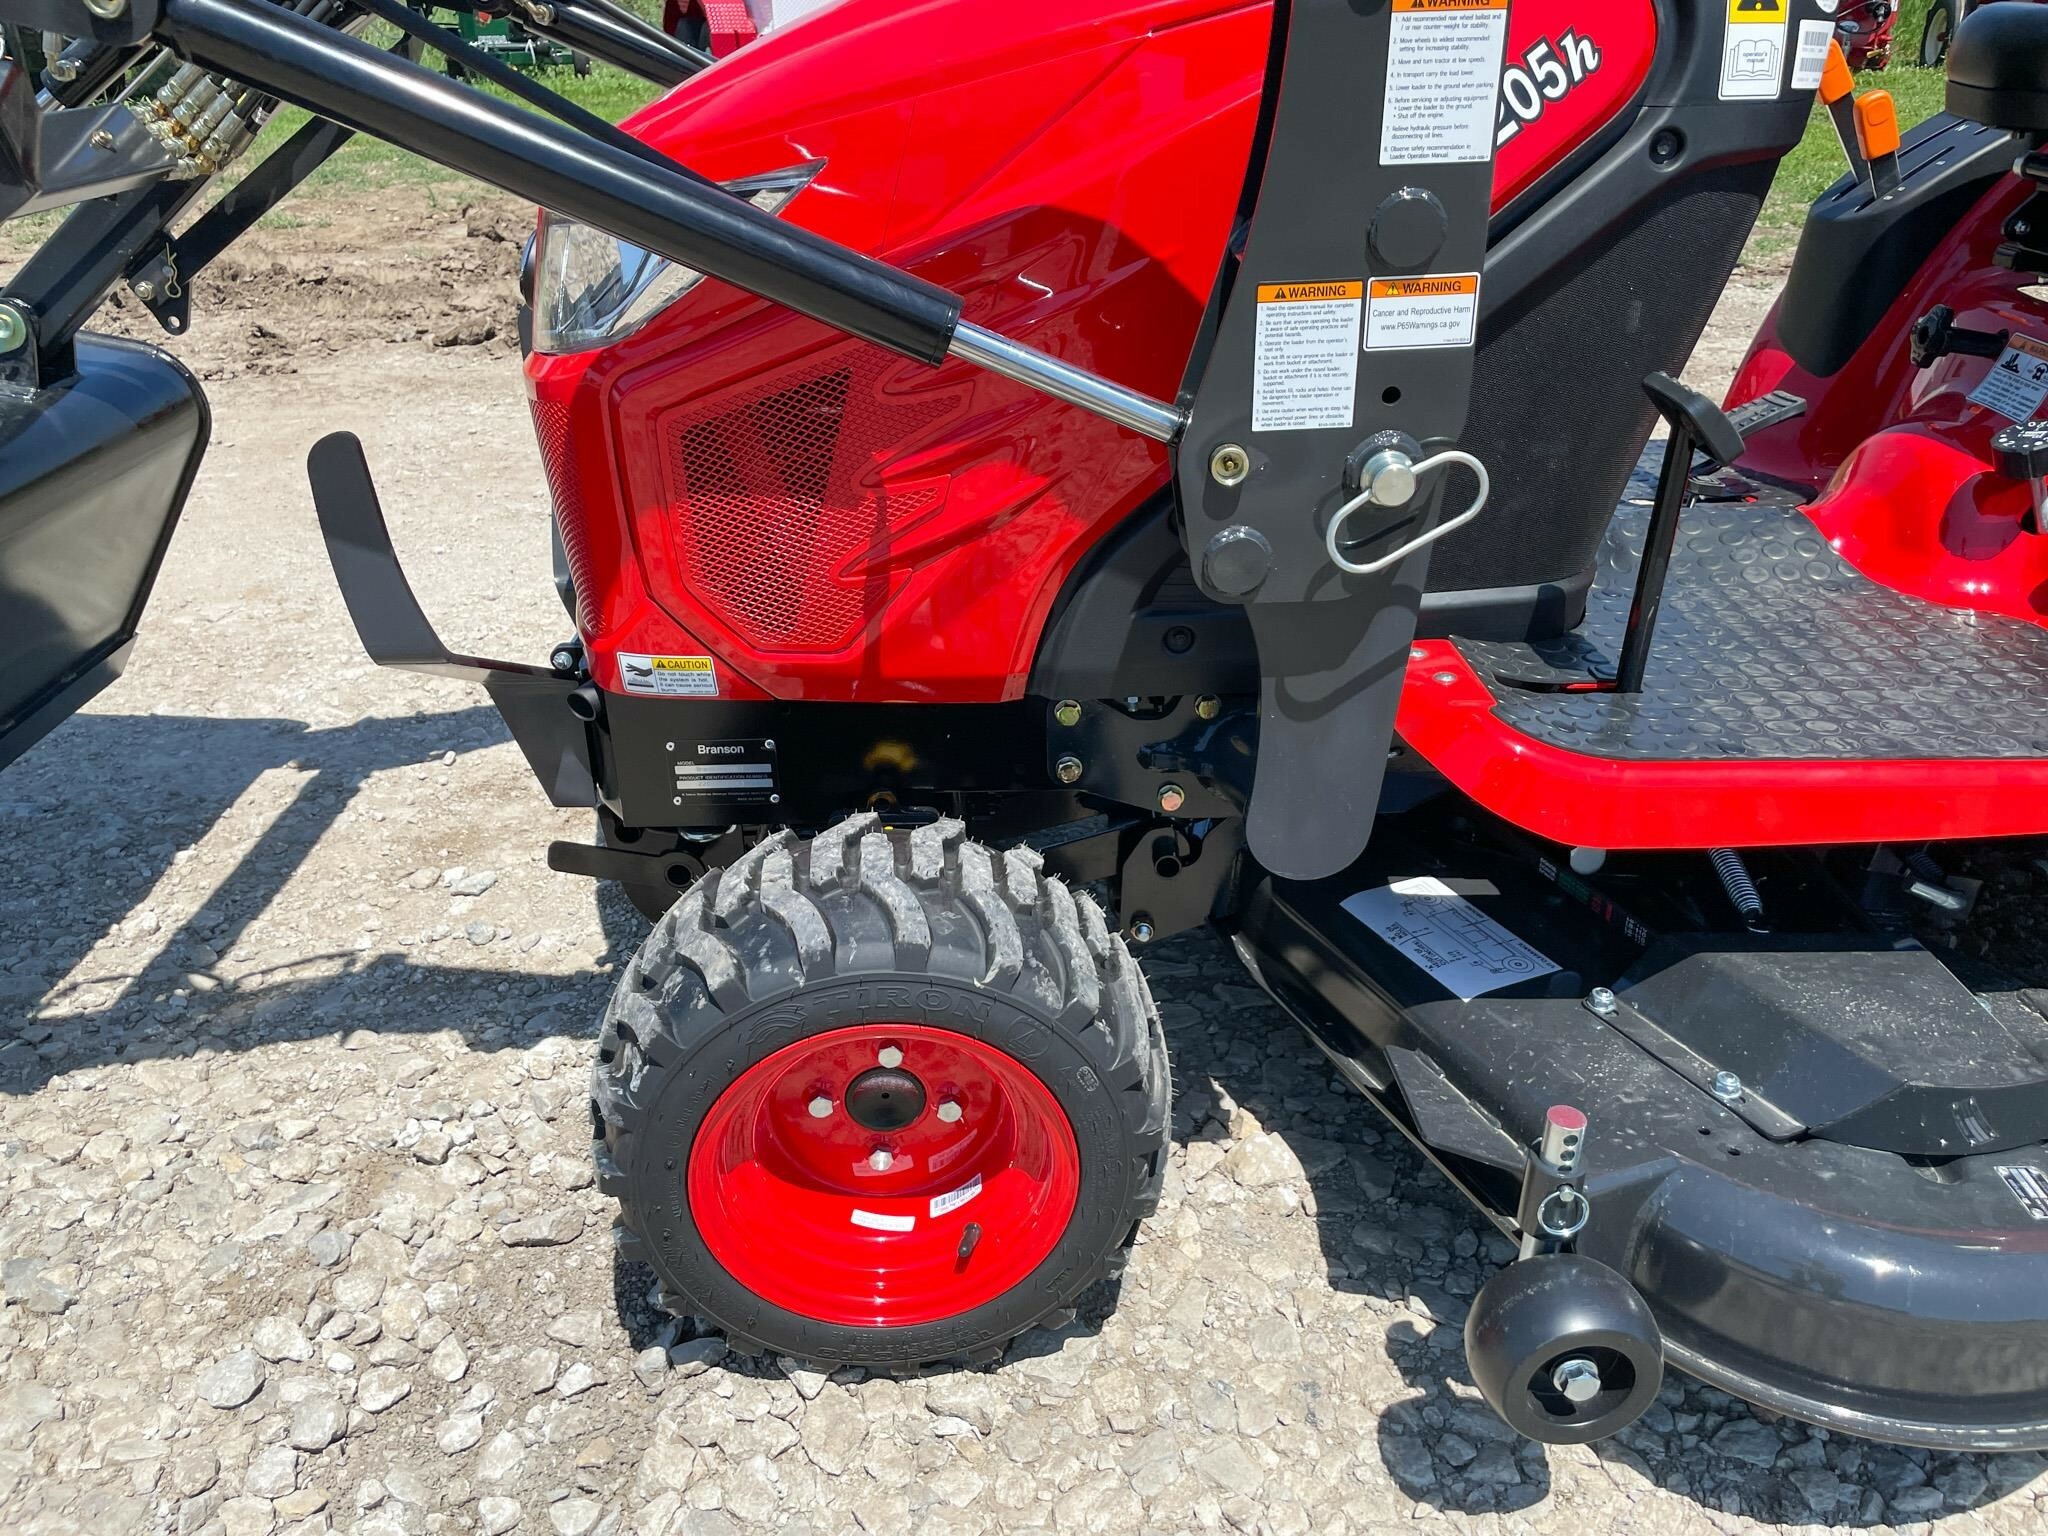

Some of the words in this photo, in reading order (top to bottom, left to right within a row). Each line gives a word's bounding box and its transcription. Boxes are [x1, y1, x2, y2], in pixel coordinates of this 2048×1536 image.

[1497, 33, 1598, 146] 05h
[1289, 286, 1346, 298] WARNING
[1403, 281, 1461, 294] WARNING
[1411, 306, 1451, 316] Reproductive
[1380, 321, 1461, 330] www.P65Warnings.ca.gov
[668, 660, 708, 669] CAUTION
[697, 745, 744, 754] Branson
